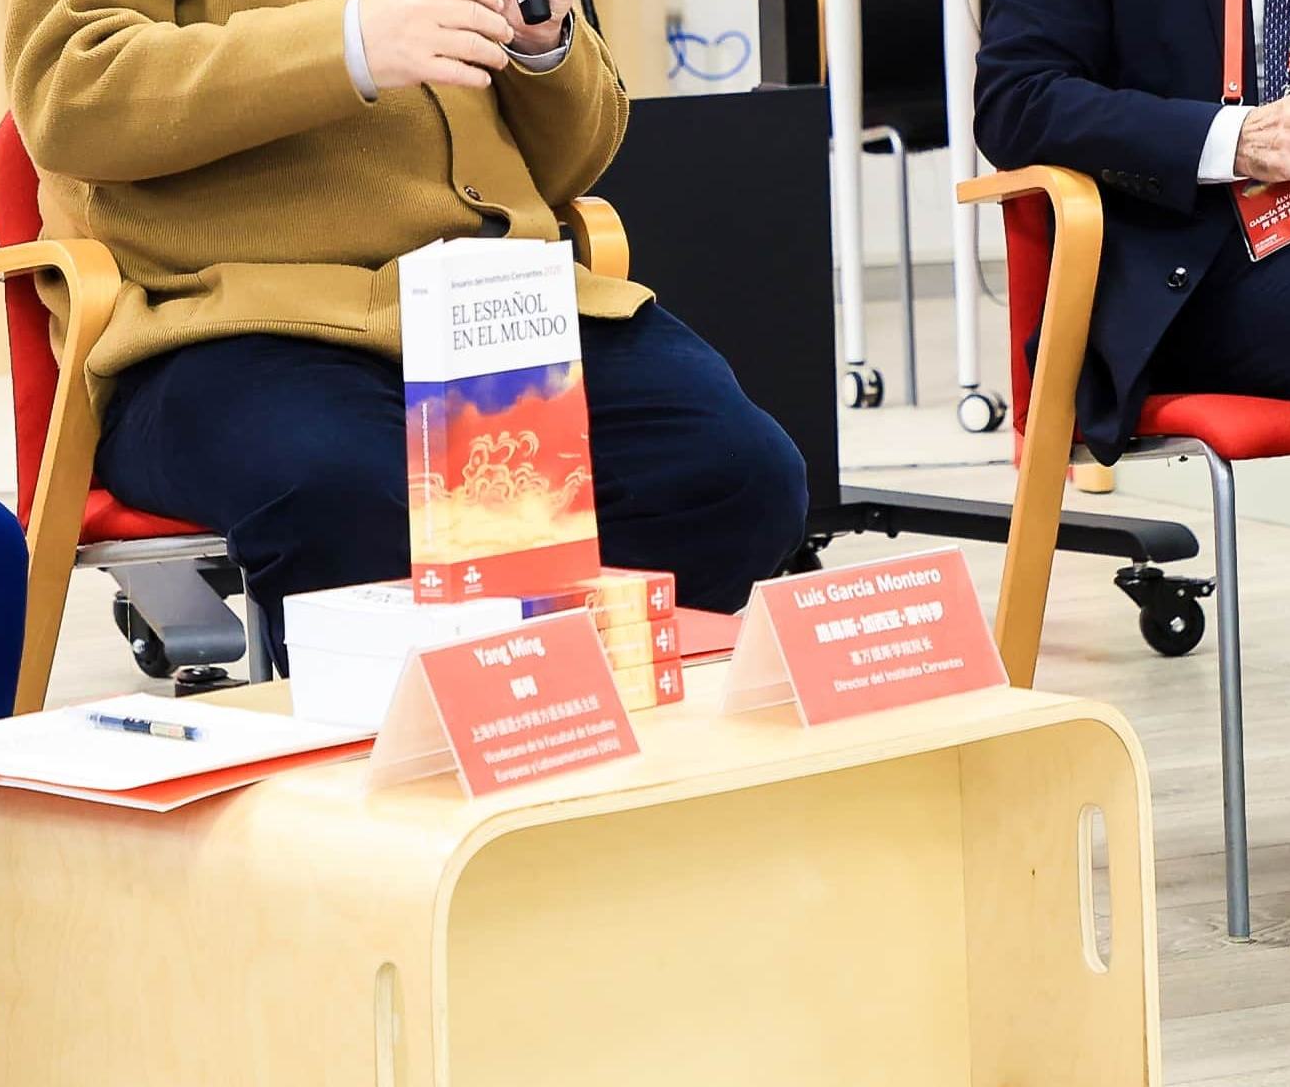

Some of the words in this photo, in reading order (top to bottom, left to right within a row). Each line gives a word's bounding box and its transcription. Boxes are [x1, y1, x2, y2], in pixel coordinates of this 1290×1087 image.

[452, 304, 471, 326] EL
[474, 290, 548, 323] ESPAÑOL
[453, 327, 473, 351] EN
[478, 325, 497, 347] EL
[501, 314, 567, 343] MUNDO
[793, 585, 826, 609] Luis
[827, 579, 875, 604] García
[876, 568, 941, 594] Montero
[473, 643, 510, 668] Yang
[507, 636, 546, 660] Ming
[833, 675, 869, 693] Director
[871, 670, 885, 684] del
[885, 665, 922, 683] Instituto
[921, 657, 964, 675] Cervantes
